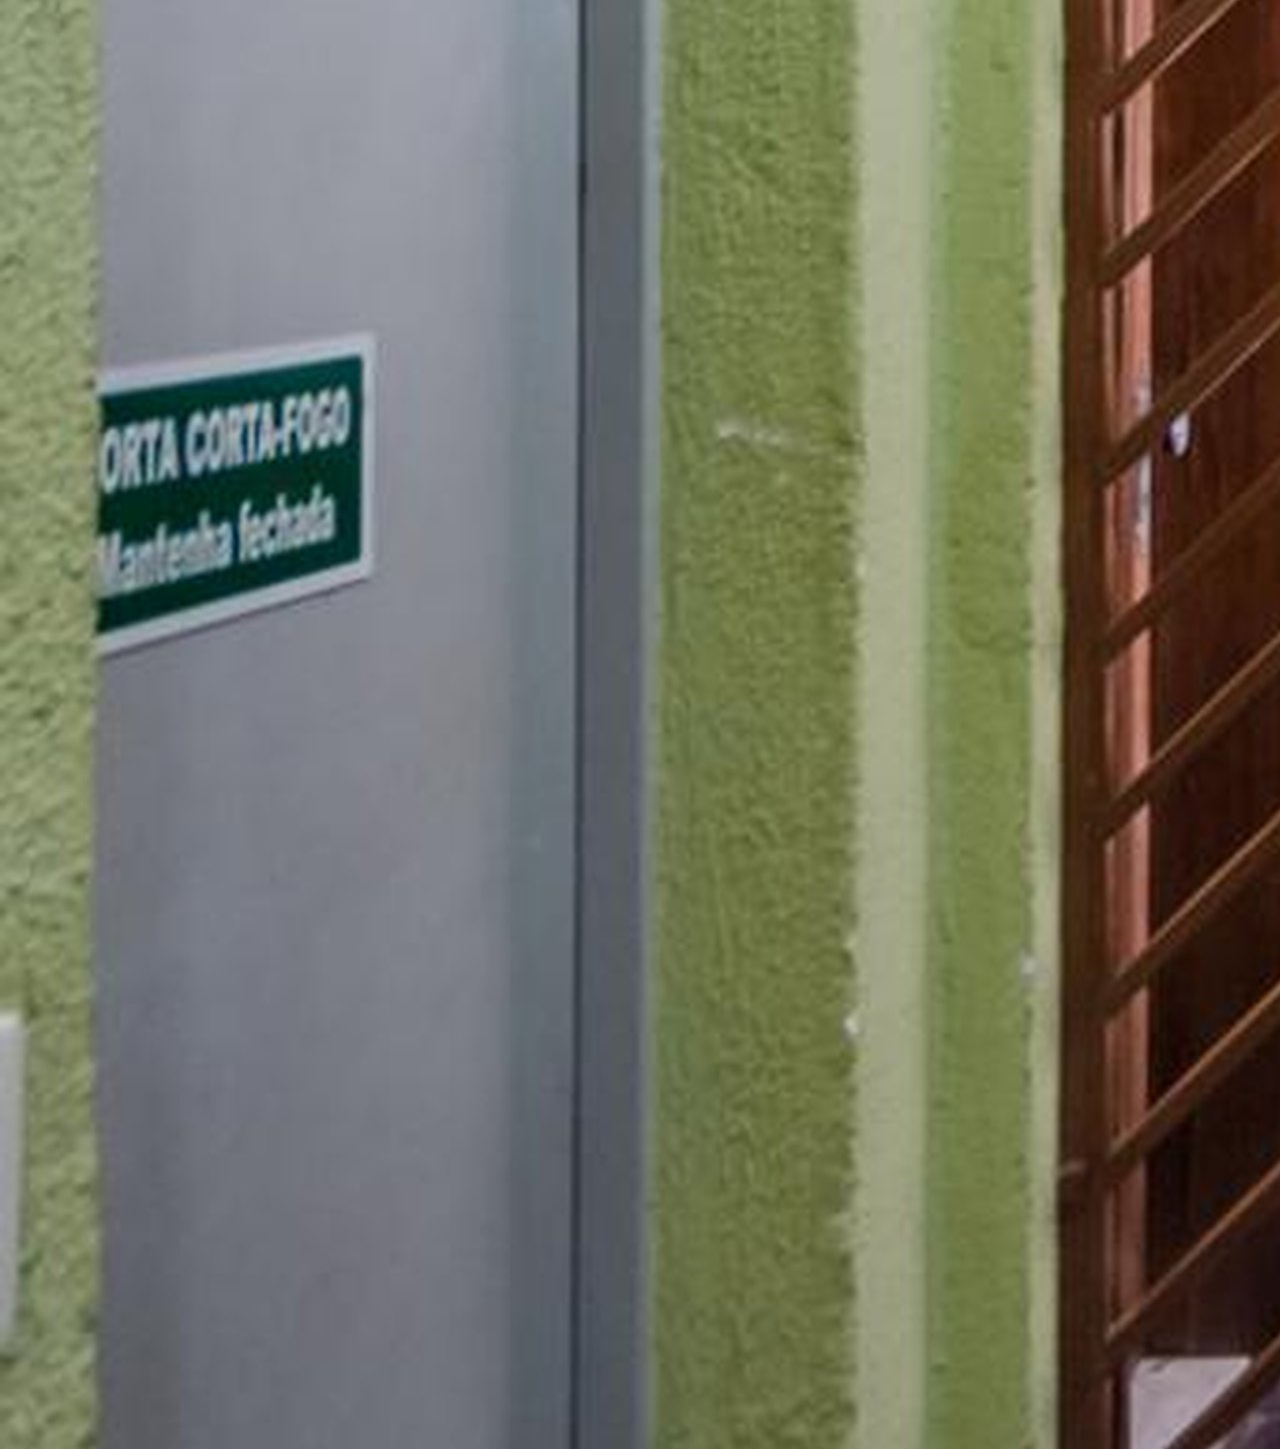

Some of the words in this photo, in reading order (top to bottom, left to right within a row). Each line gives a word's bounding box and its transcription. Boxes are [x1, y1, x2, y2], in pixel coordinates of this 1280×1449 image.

[101, 417, 179, 493] ORTA
[184, 385, 350, 476] CORTA-FOGO
[238, 482, 336, 563] fechada
